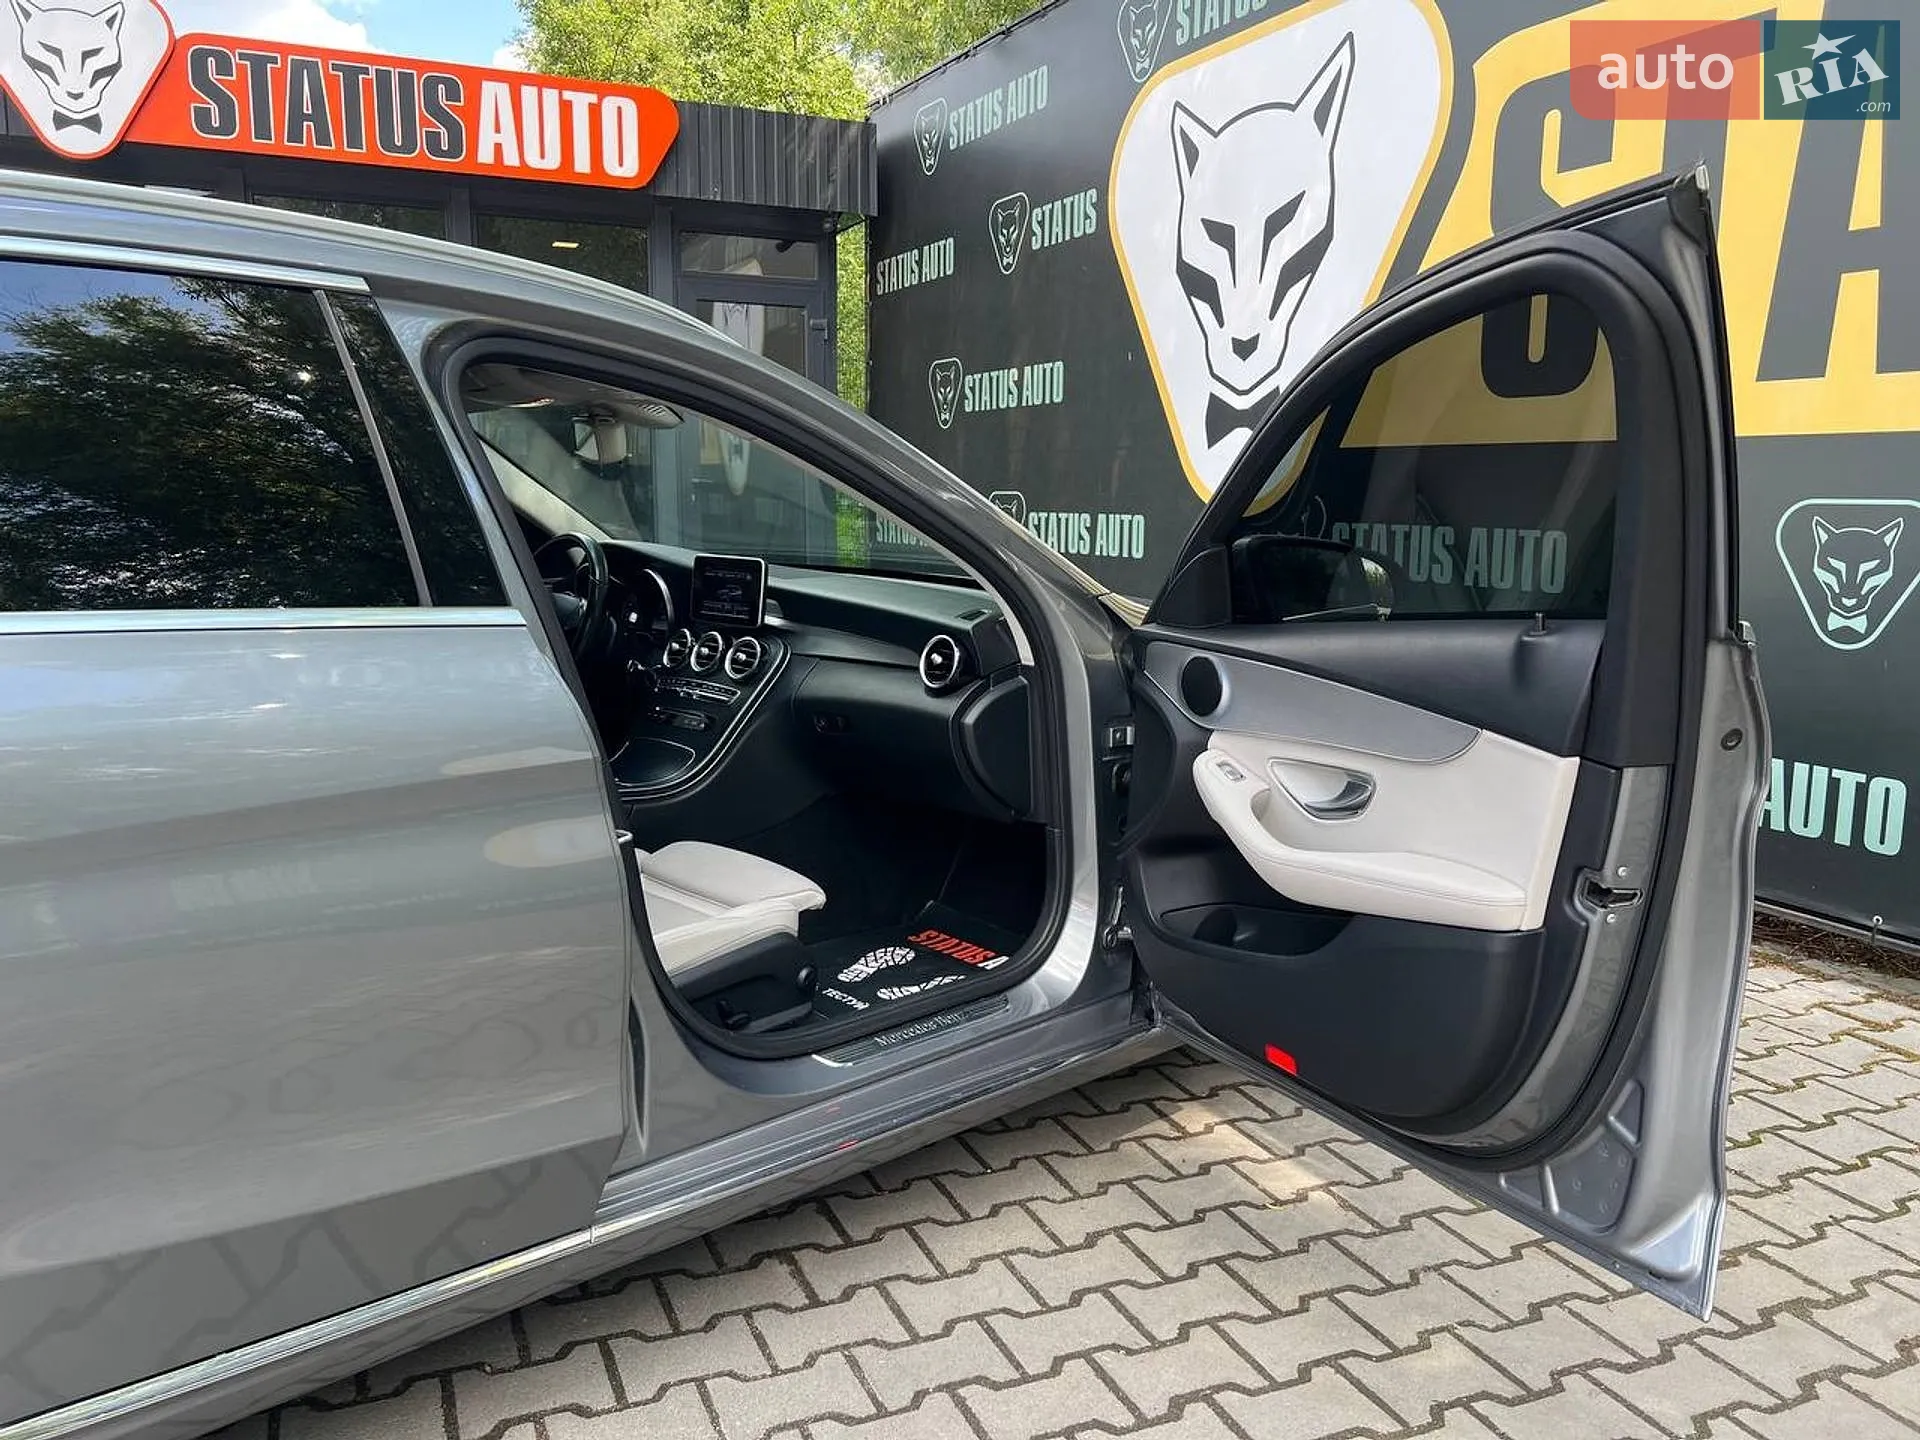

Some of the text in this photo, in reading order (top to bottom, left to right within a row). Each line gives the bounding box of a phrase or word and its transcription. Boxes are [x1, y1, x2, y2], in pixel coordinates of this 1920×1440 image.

[188, 46, 639, 178] STATUS AUTO
[949, 64, 1049, 151] STATUS AUTO
[1031, 188, 1098, 250] STATUS
[876, 237, 955, 296] STATUS AUTO
[964, 360, 1064, 413] STATUS AUTO
[1028, 511, 1145, 559] STATUS AUTO
[1464, 527, 1567, 594] AUTO
[1758, 757, 1908, 856] AUTO
